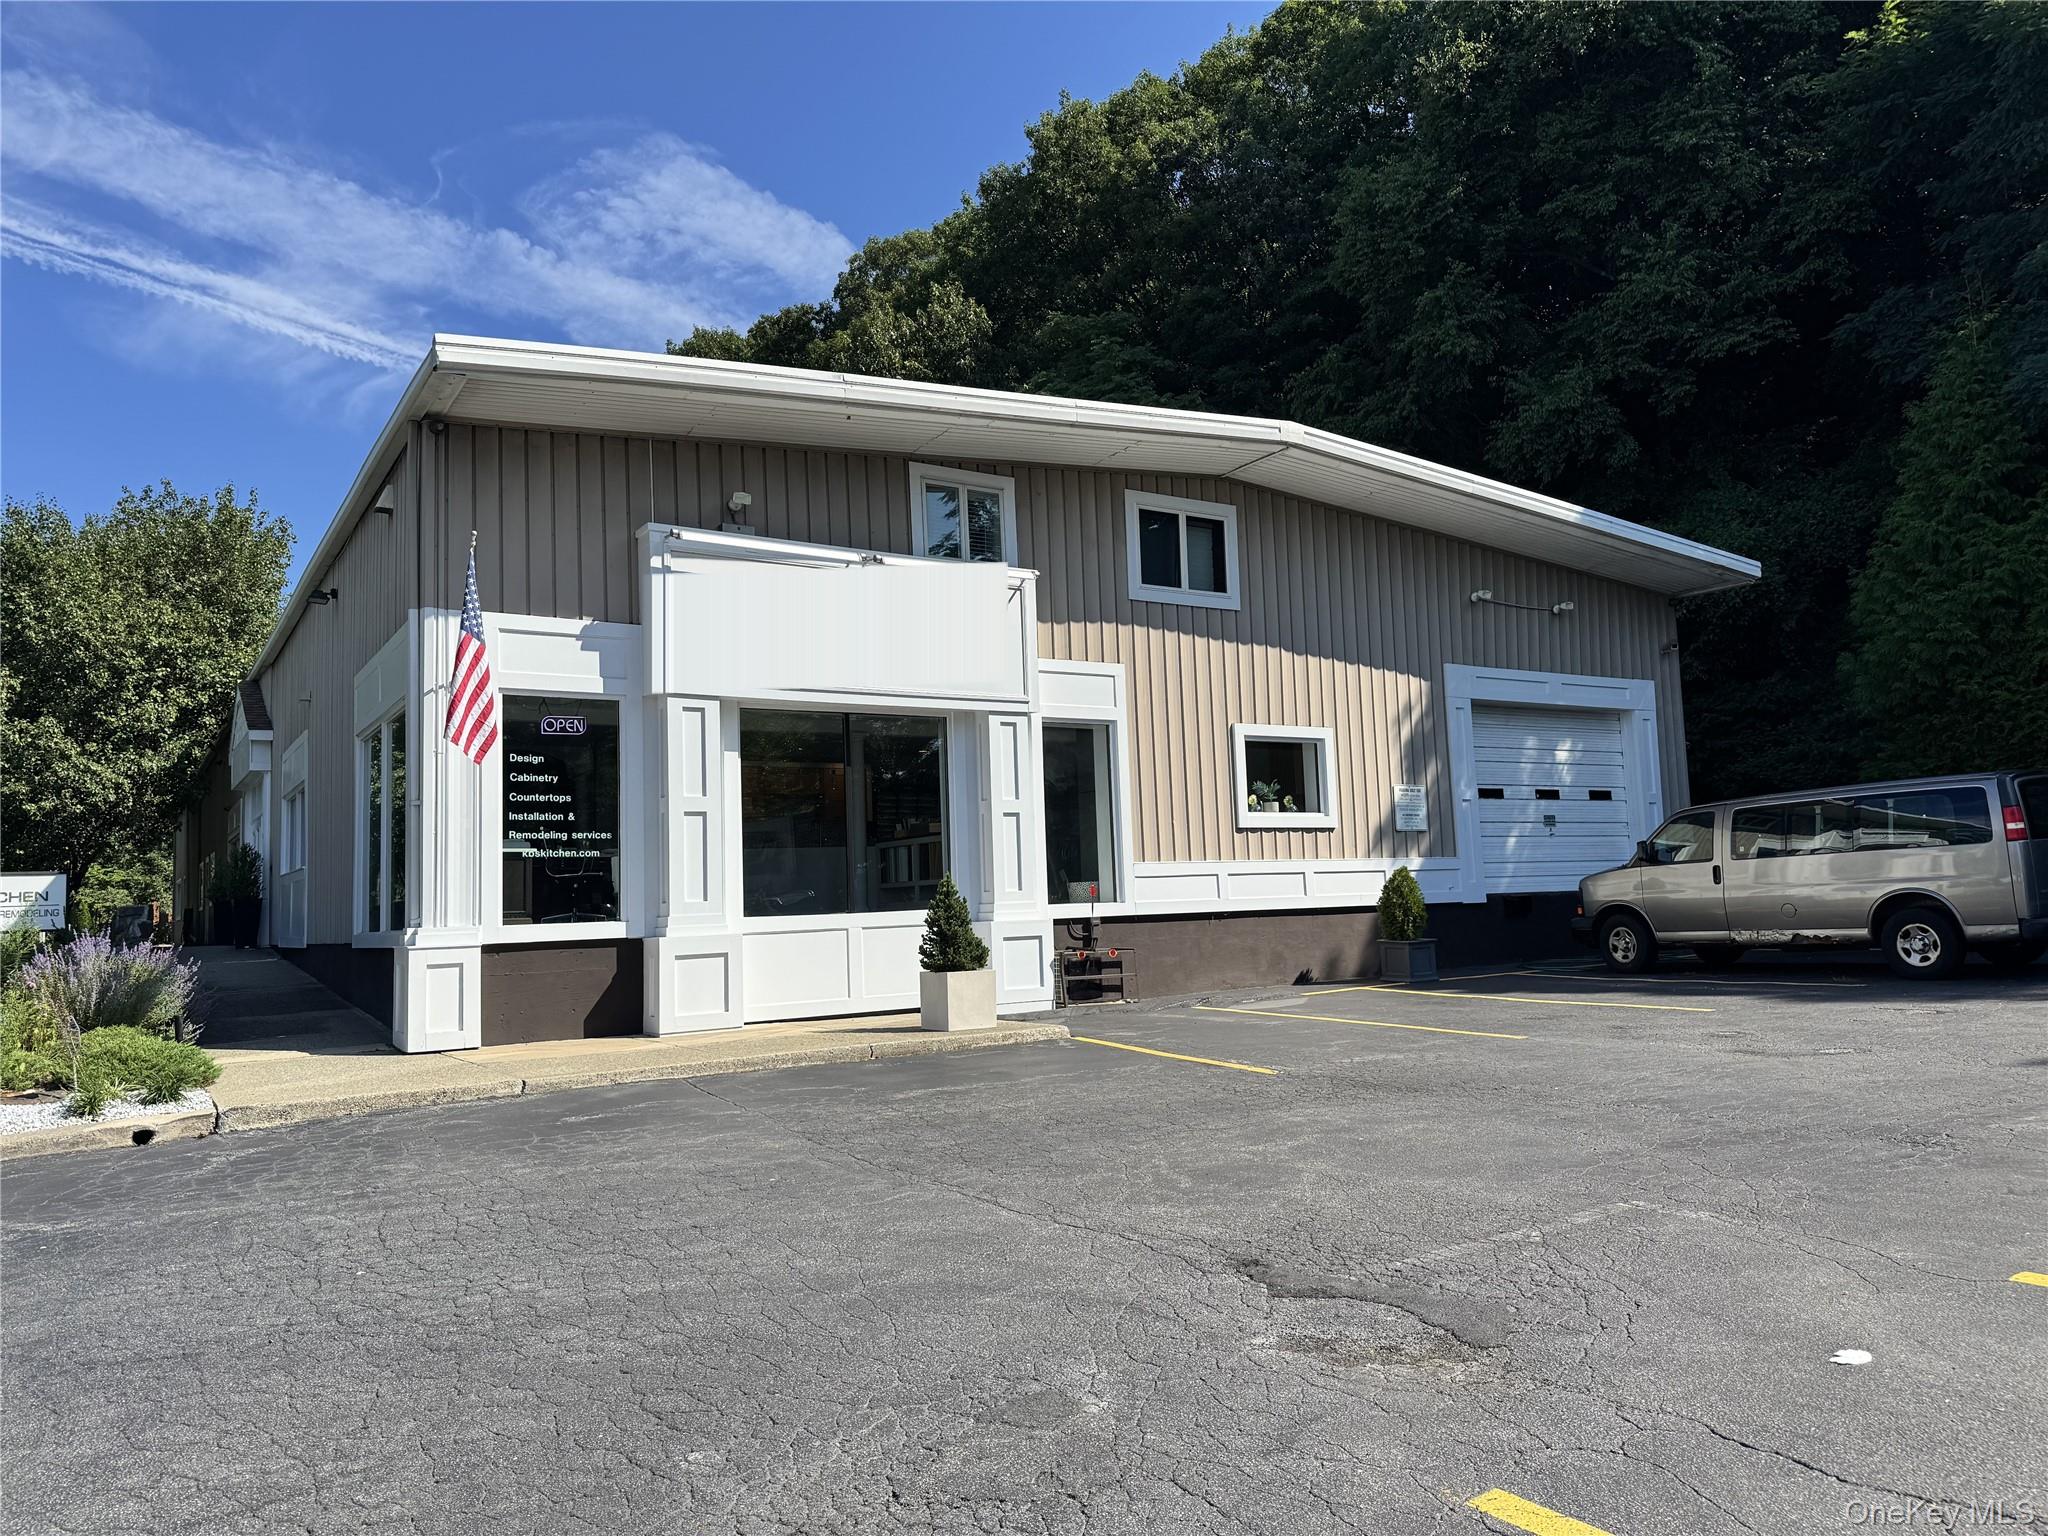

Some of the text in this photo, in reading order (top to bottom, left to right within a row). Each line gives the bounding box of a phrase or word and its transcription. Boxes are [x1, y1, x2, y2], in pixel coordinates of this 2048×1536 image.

[544, 718, 584, 733] OPEN
[509, 753, 545, 765] Design
[509, 773, 559, 784] Cabinetry
[509, 793, 572, 804] Countertops
[509, 812, 576, 821] Installation &
[509, 831, 613, 840] Remodeling services
